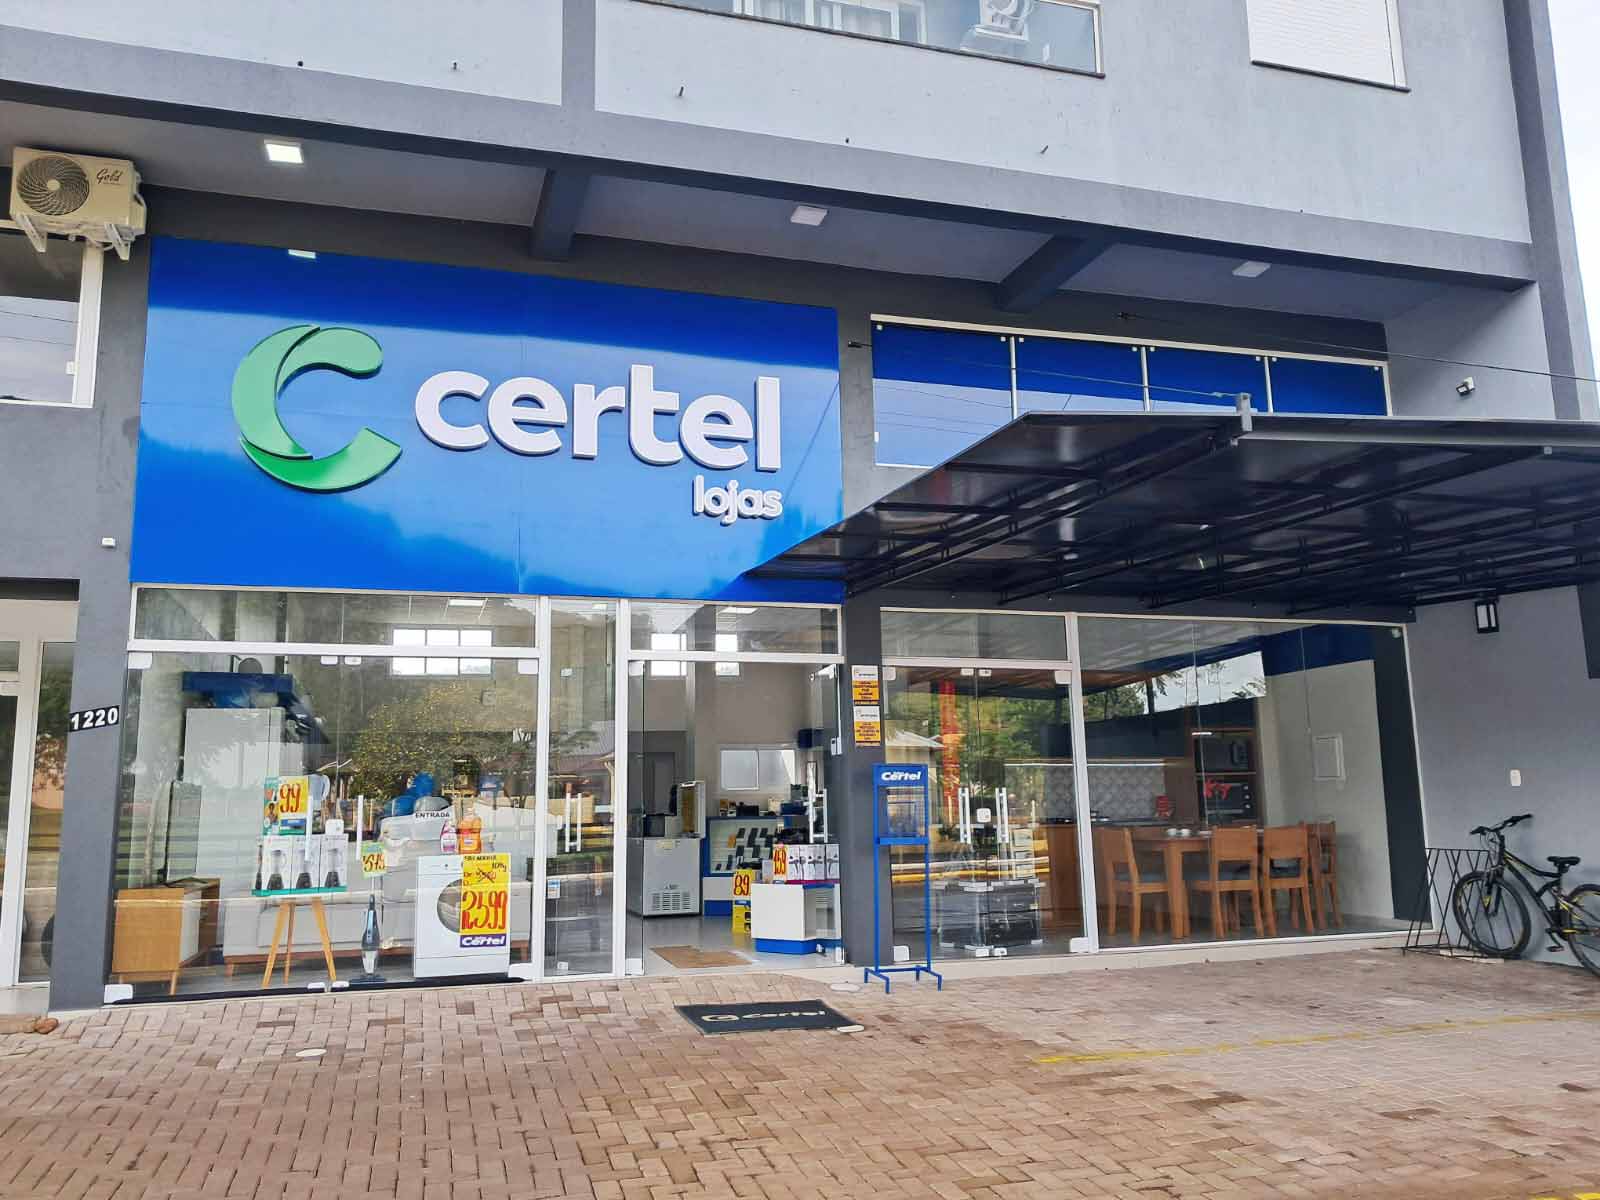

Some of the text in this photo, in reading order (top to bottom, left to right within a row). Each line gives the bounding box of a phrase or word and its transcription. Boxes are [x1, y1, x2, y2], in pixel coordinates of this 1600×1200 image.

[96, 167, 123, 184] Gold
[414, 364, 782, 473] certel
[692, 474, 783, 526] lojas
[71, 707, 118, 730] 1220
[881, 771, 921, 781] Certel
[733, 873, 750, 896] 89
[461, 936, 505, 946] Certel
